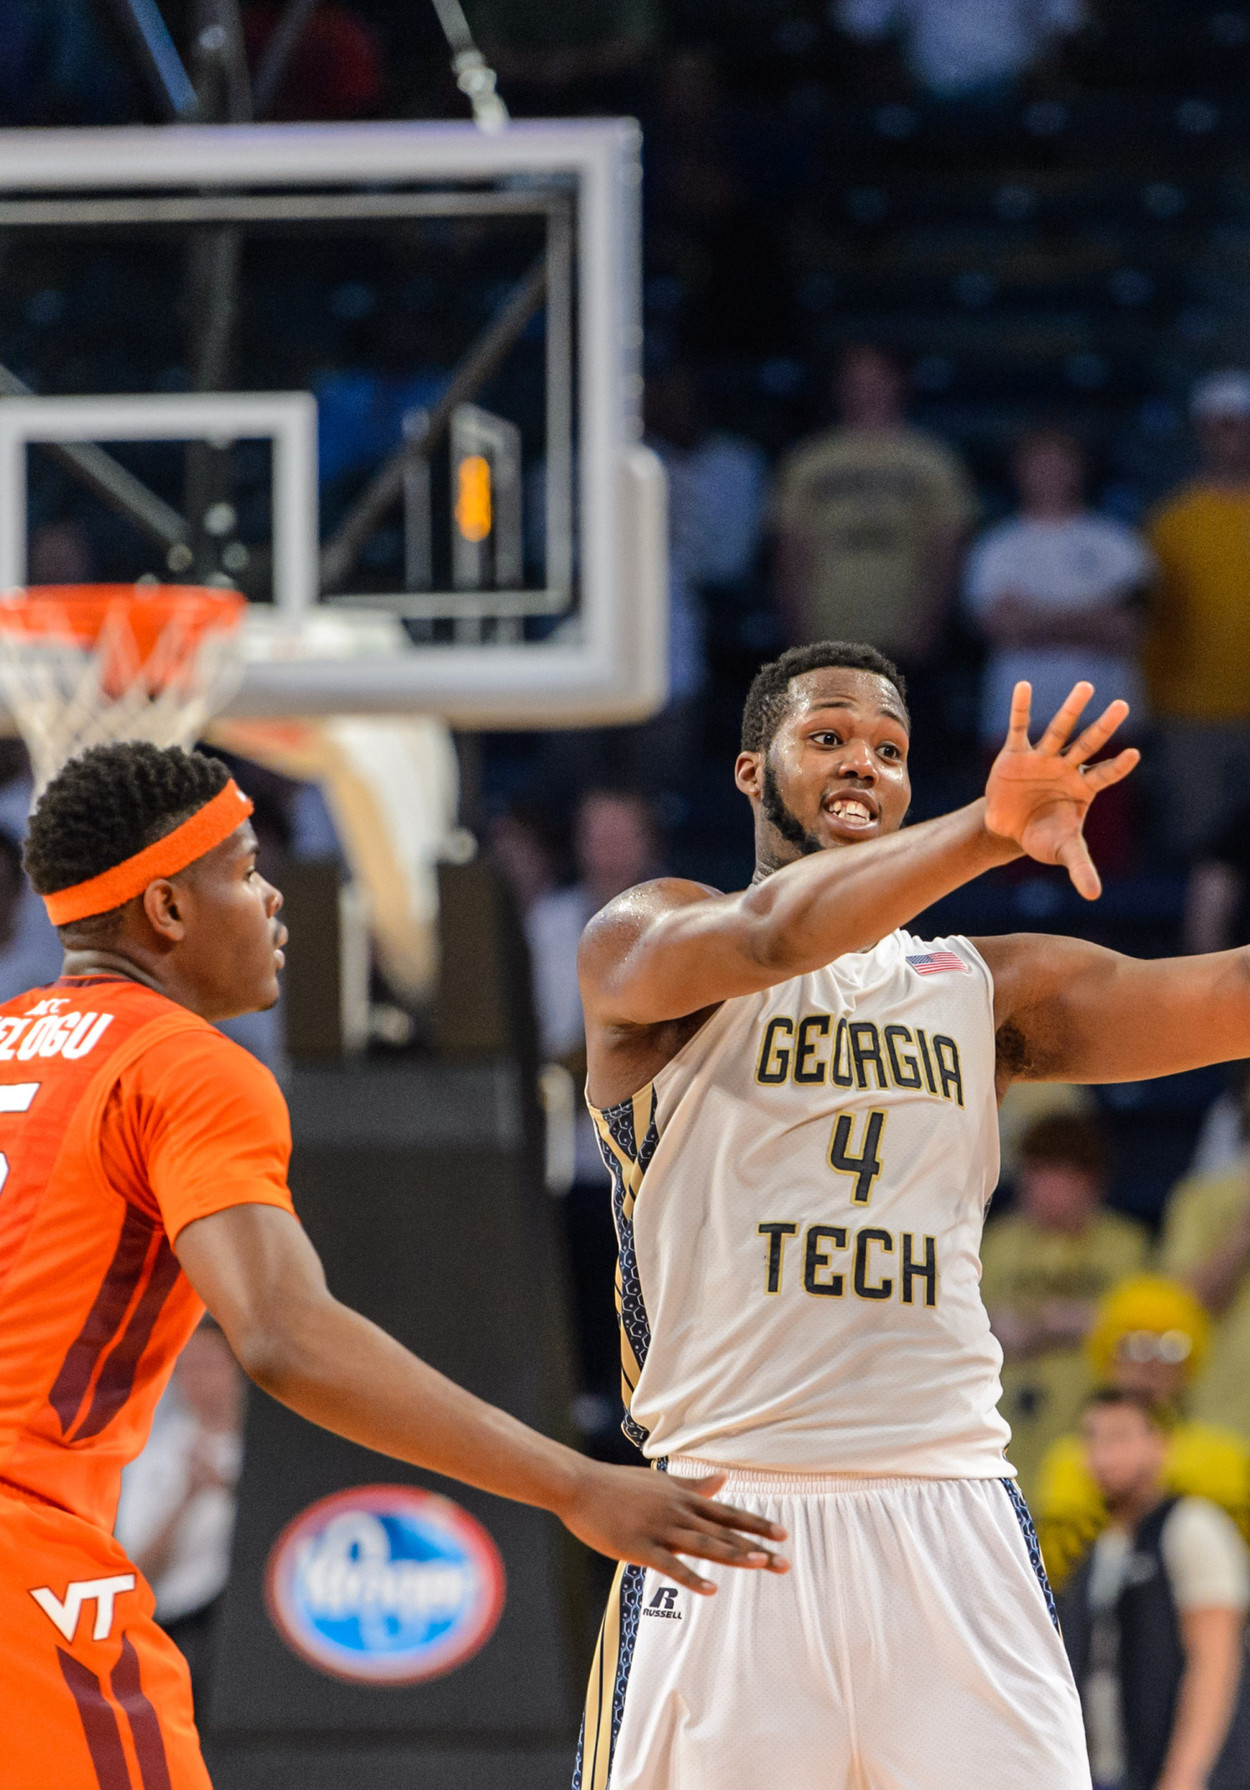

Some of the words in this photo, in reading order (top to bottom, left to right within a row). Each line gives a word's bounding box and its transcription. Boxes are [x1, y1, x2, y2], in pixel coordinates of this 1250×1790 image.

[754, 1013, 966, 1110] GEORGIA
[826, 1107, 889, 1207] 4
[756, 1221, 938, 1309] TECH
[29, 1573, 136, 1644] VT
[642, 1607, 683, 1620] RUSSELL
